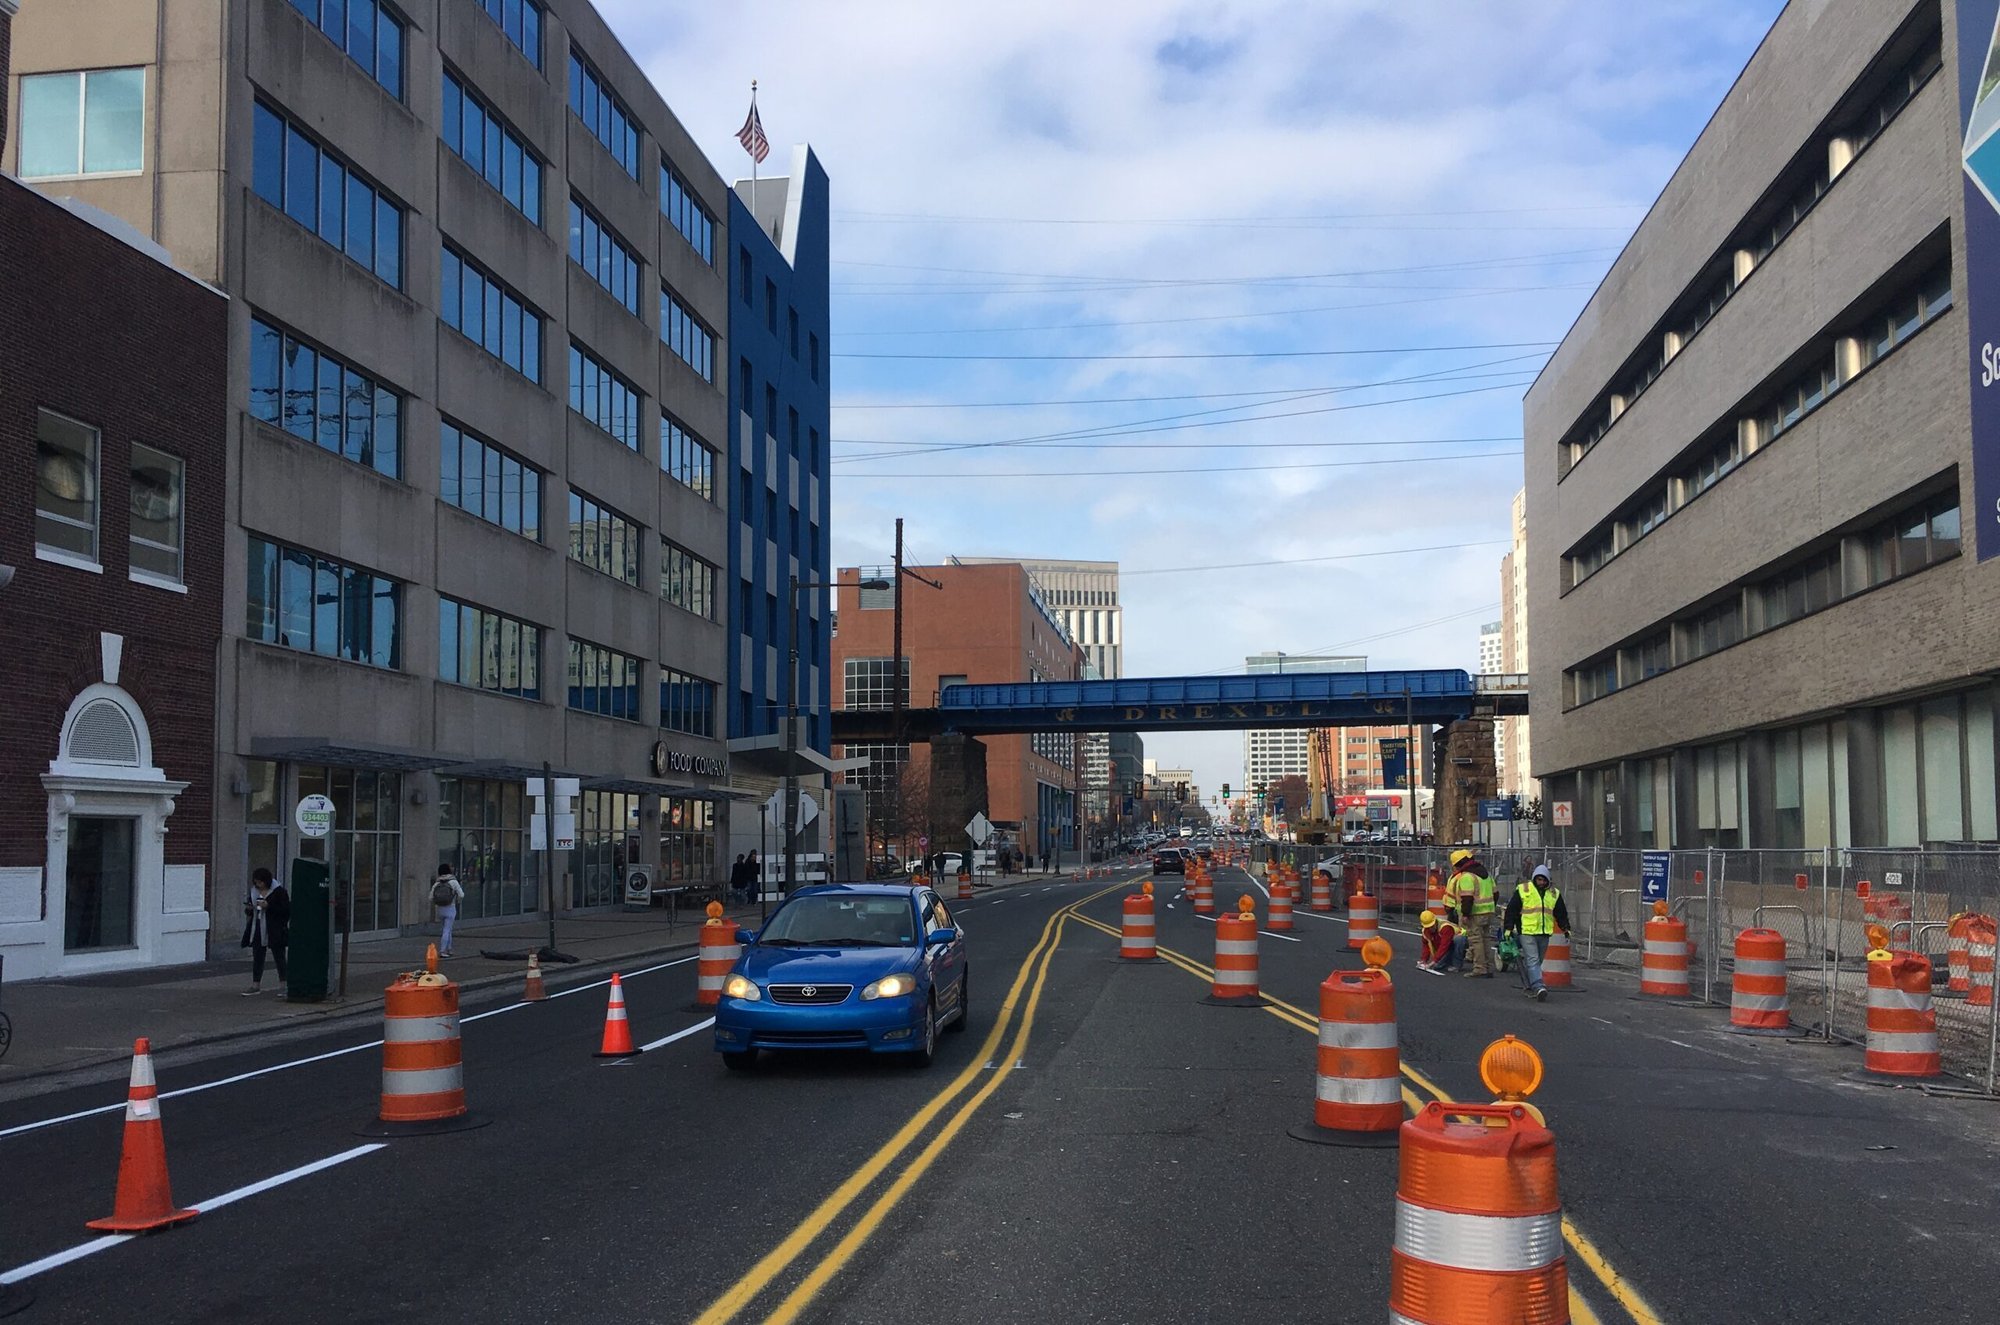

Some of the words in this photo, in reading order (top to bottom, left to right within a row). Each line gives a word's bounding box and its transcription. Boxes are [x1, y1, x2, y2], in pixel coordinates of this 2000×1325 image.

[1123, 703, 1321, 721] DREXEL
[670, 751, 692, 772] FOOD
[695, 755, 728, 778] COMPANY
